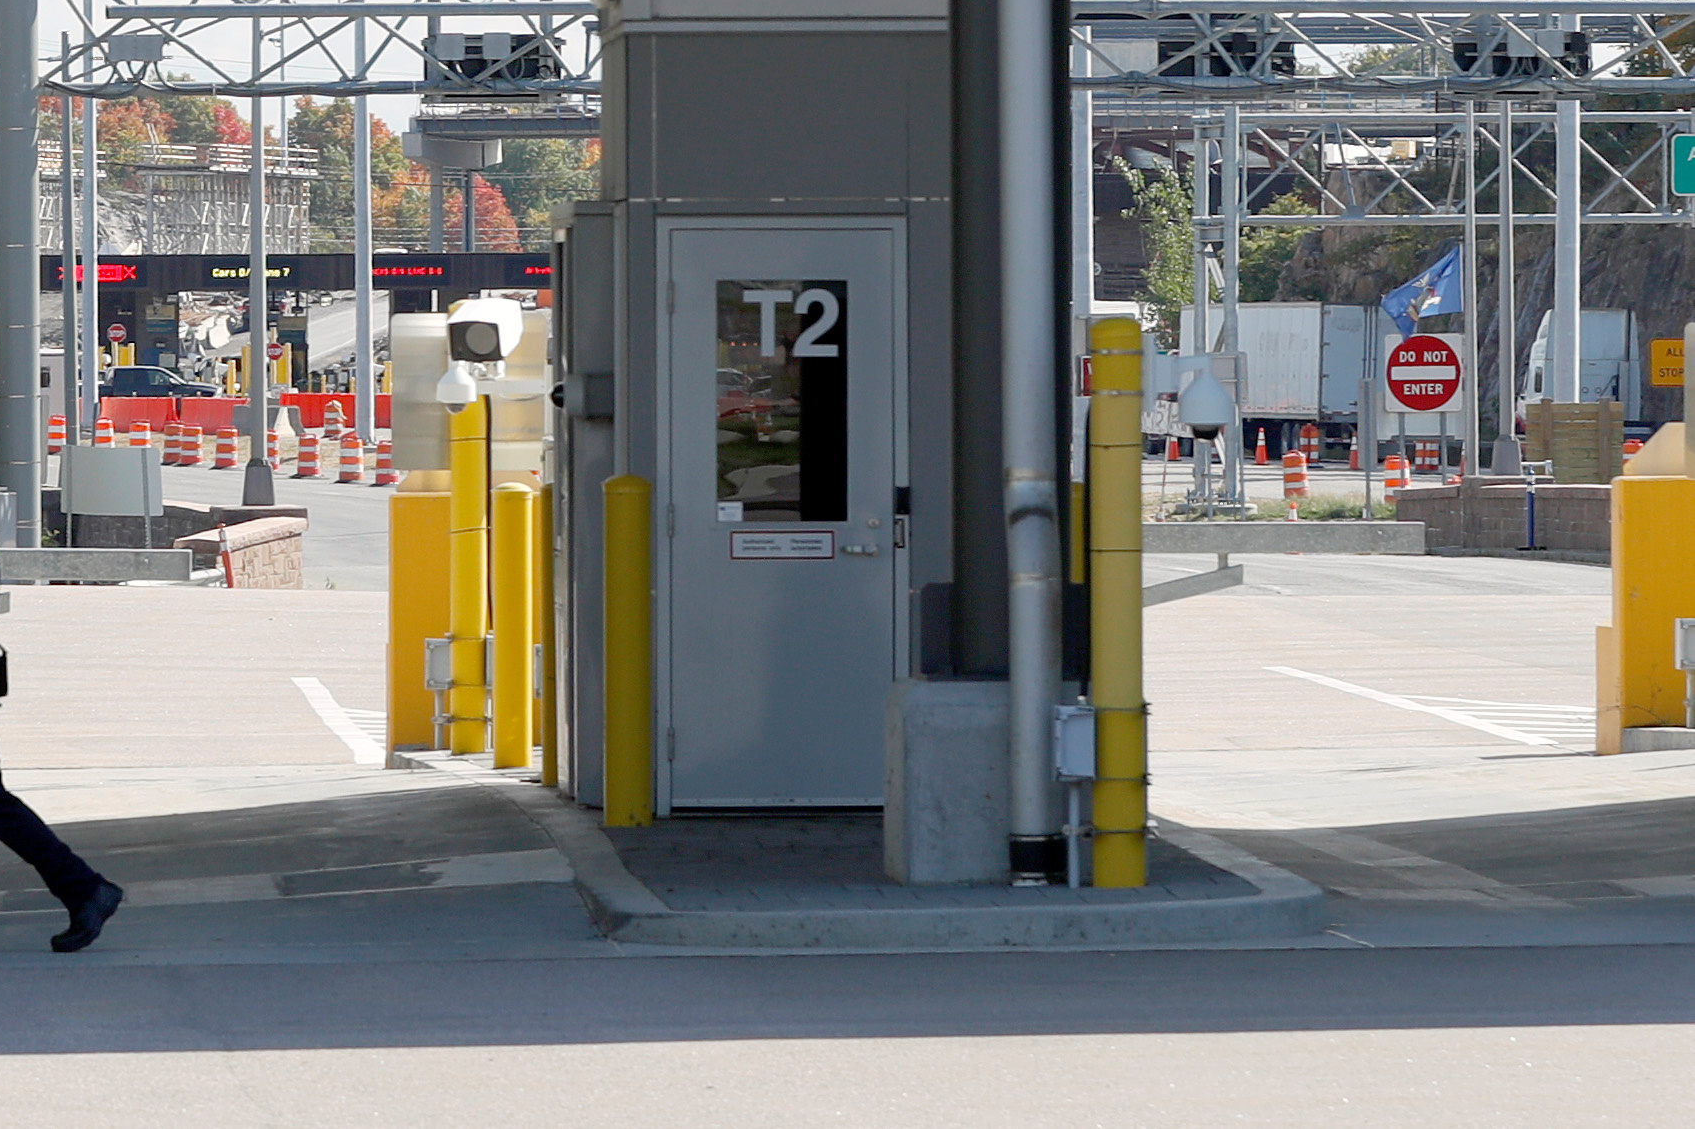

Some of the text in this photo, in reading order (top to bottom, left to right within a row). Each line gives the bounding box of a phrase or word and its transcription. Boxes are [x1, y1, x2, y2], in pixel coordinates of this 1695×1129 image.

[212, 268, 236, 278] Cars
[283, 267, 290, 277] 7
[743, 288, 840, 357] T2
[1399, 351, 1448, 363] DO NOT
[1659, 368, 1685, 378] STOP
[1403, 383, 1444, 395] ENTER
